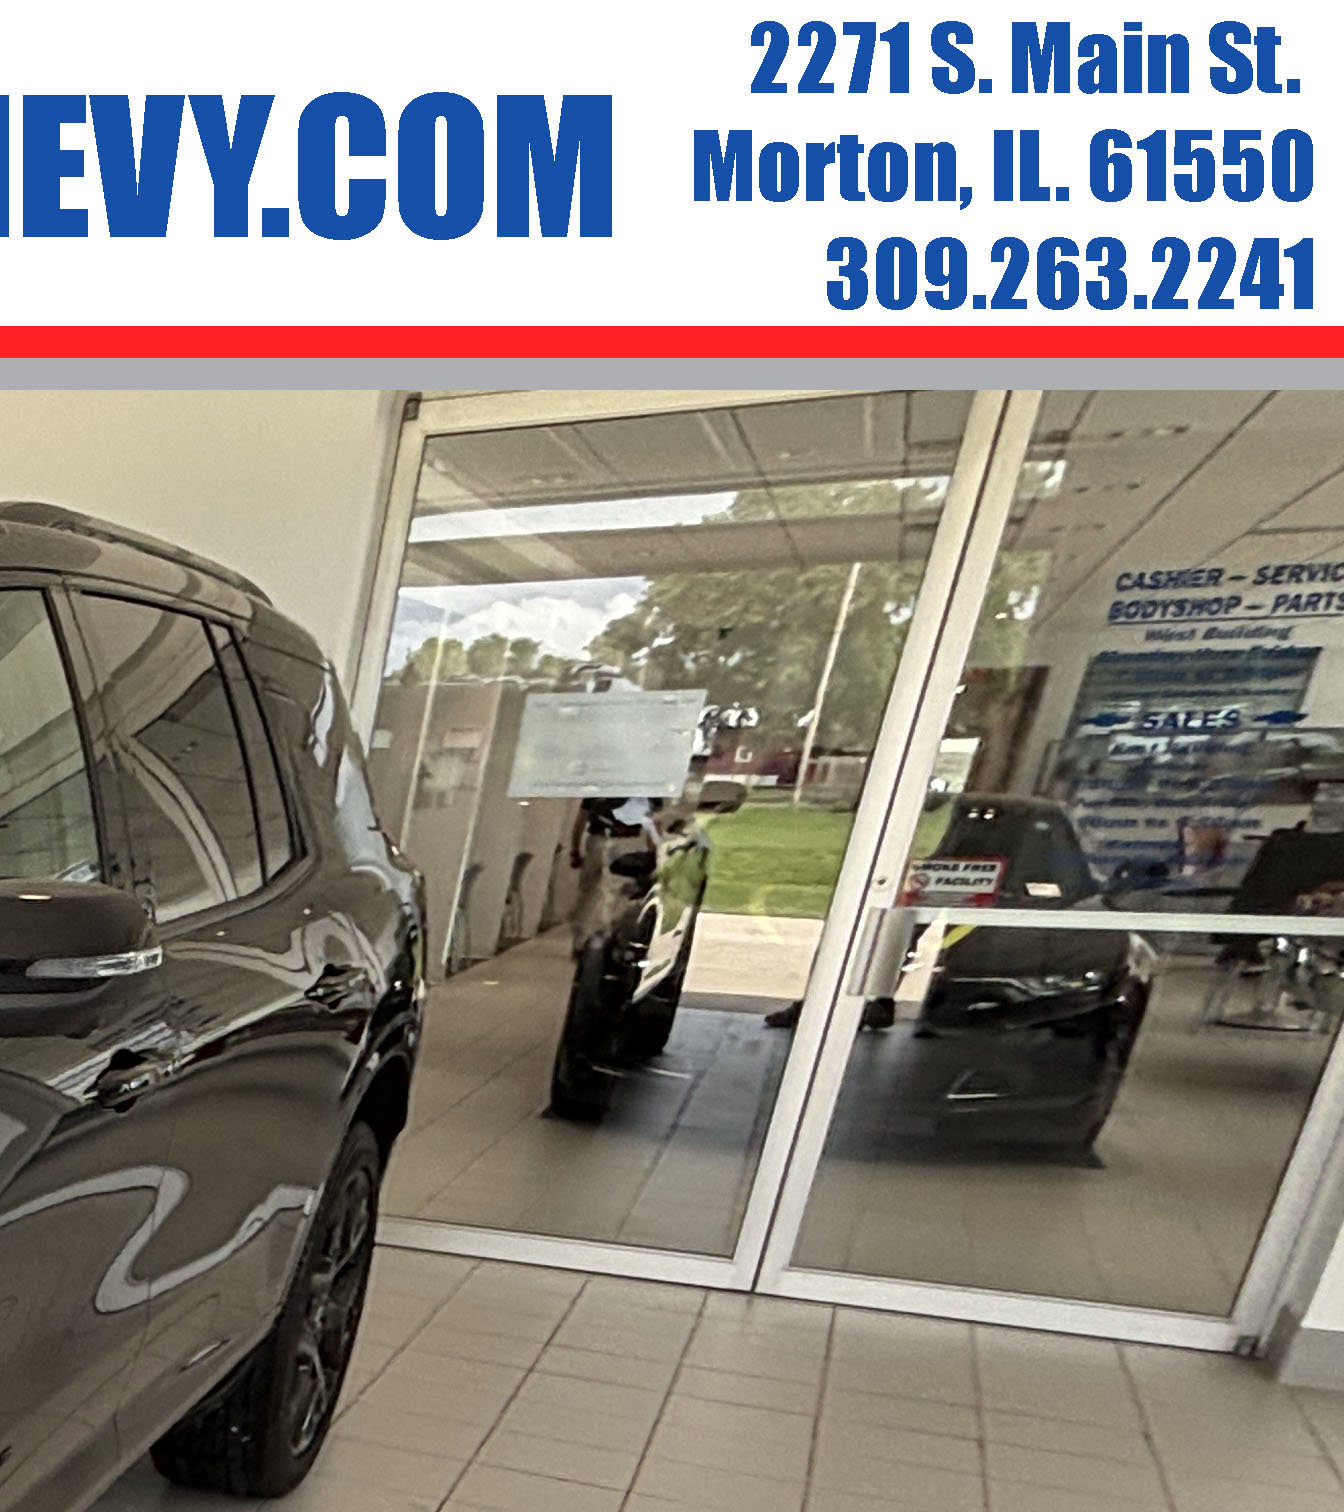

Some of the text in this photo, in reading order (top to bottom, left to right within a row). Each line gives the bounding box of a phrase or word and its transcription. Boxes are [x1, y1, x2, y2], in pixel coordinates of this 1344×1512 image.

[1252, 561, 1344, 585] SERVIC
[1108, 595, 1242, 622] BODYSHOP
[1142, 710, 1241, 732] SALES
